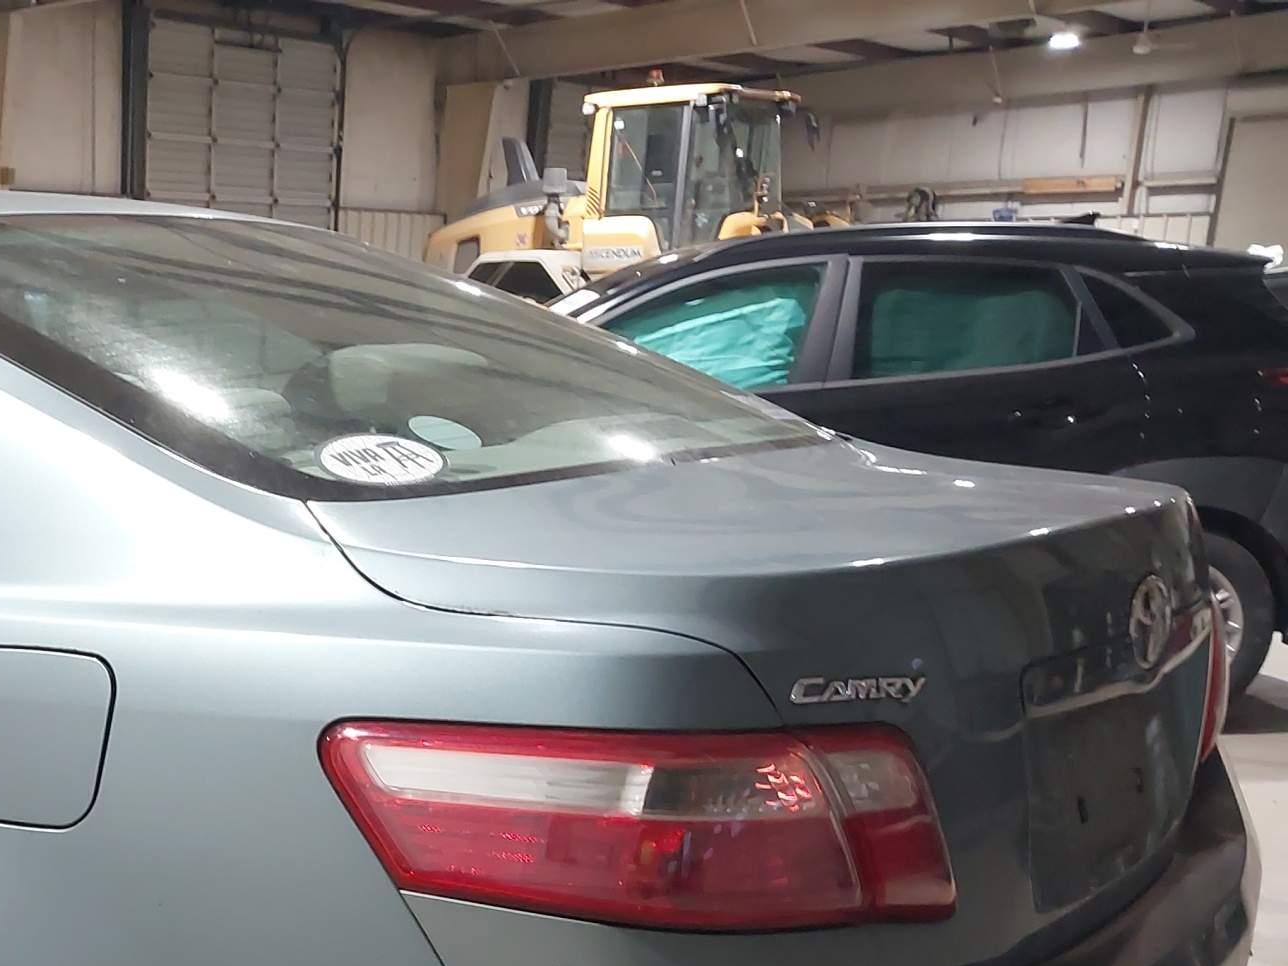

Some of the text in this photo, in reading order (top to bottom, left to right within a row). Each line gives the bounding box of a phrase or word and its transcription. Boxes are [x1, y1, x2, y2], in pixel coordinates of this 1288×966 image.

[329, 447, 386, 467] VIVA
[361, 465, 388, 476] LA
[789, 676, 927, 704] CAMRY
